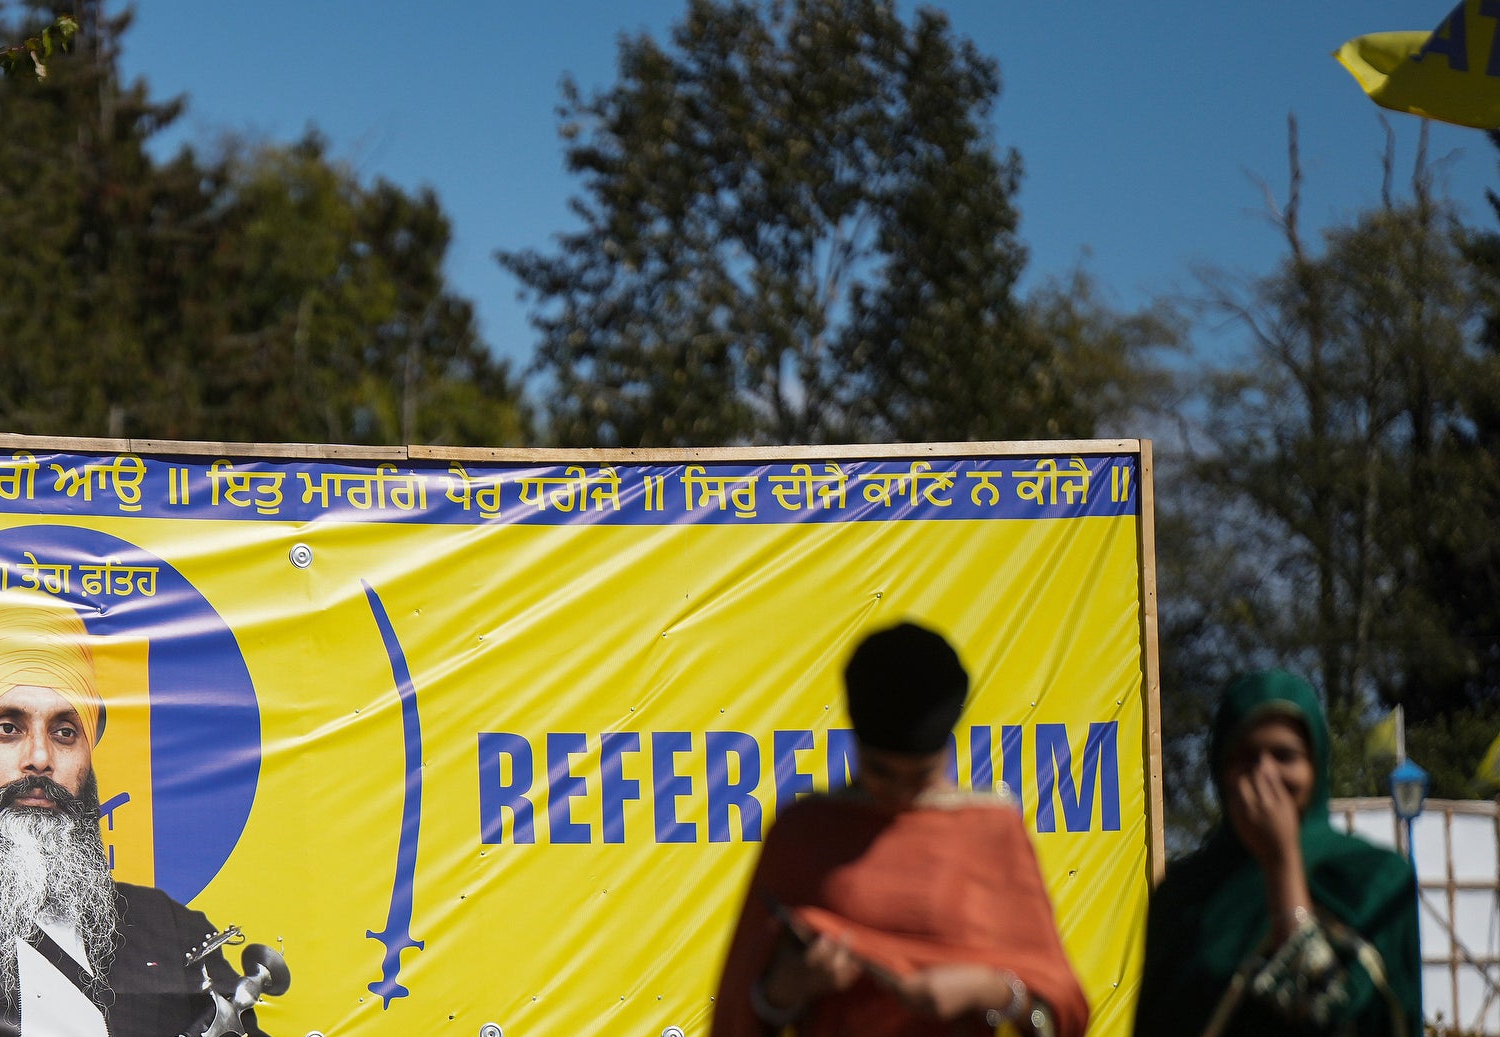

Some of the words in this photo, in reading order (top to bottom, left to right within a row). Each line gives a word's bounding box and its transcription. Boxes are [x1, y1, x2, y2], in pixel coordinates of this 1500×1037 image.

[51, 453, 147, 511] ਆਉ
[206, 459, 286, 515] ਇਤੁ
[297, 463, 428, 511] ਮਾਰਗਿ
[680, 465, 759, 518] ਸਿਰੁ
[768, 460, 848, 510] ਦੀਜੈ
[858, 461, 956, 507] ਕਾਣਿ
[966, 471, 1002, 507] ਨ
[1012, 456, 1092, 505] ਕੀਜੈ
[477, 721, 1120, 844] REFEREUM
